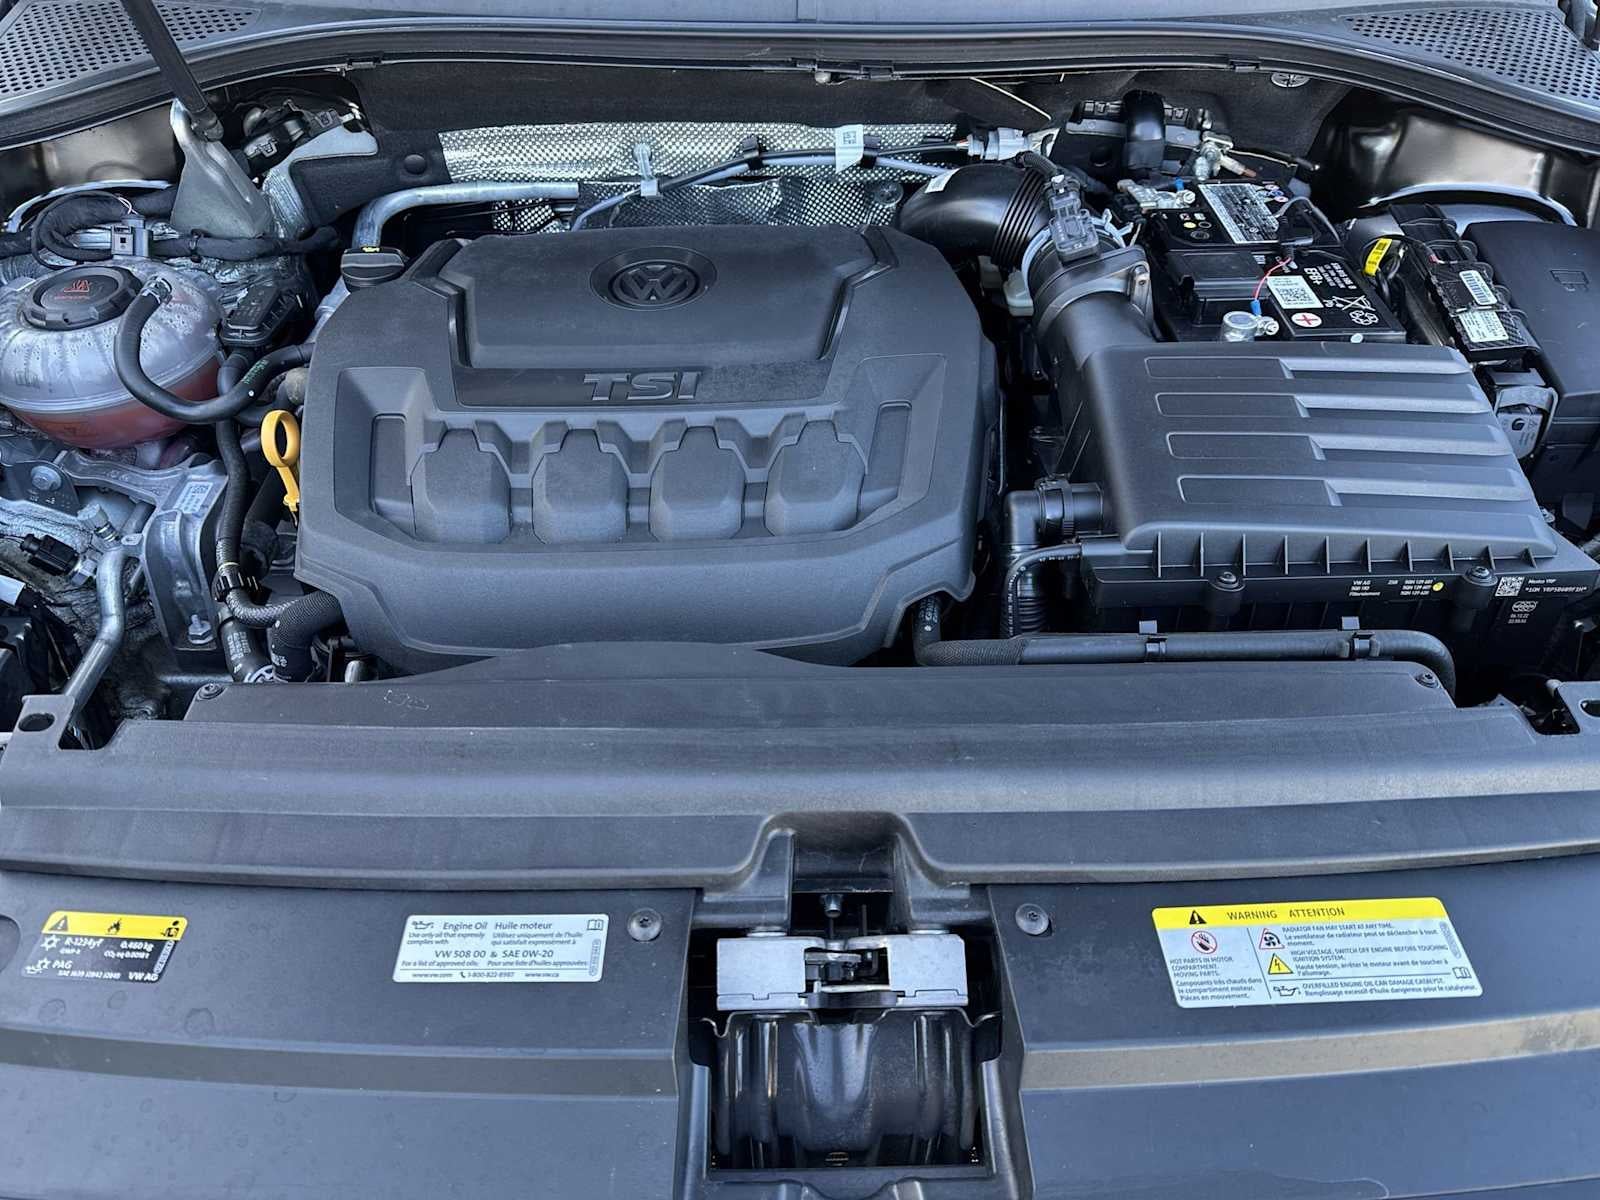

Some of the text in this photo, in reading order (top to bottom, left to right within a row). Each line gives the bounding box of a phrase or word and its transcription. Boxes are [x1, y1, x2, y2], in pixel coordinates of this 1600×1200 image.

[584, 372, 703, 401] TSI
[1227, 910, 1278, 920] WARNING
[1287, 907, 1345, 917] ATTENTION
[442, 922, 473, 931] Engine
[51, 960, 73, 968] PAG
[127, 972, 144, 980] VW
